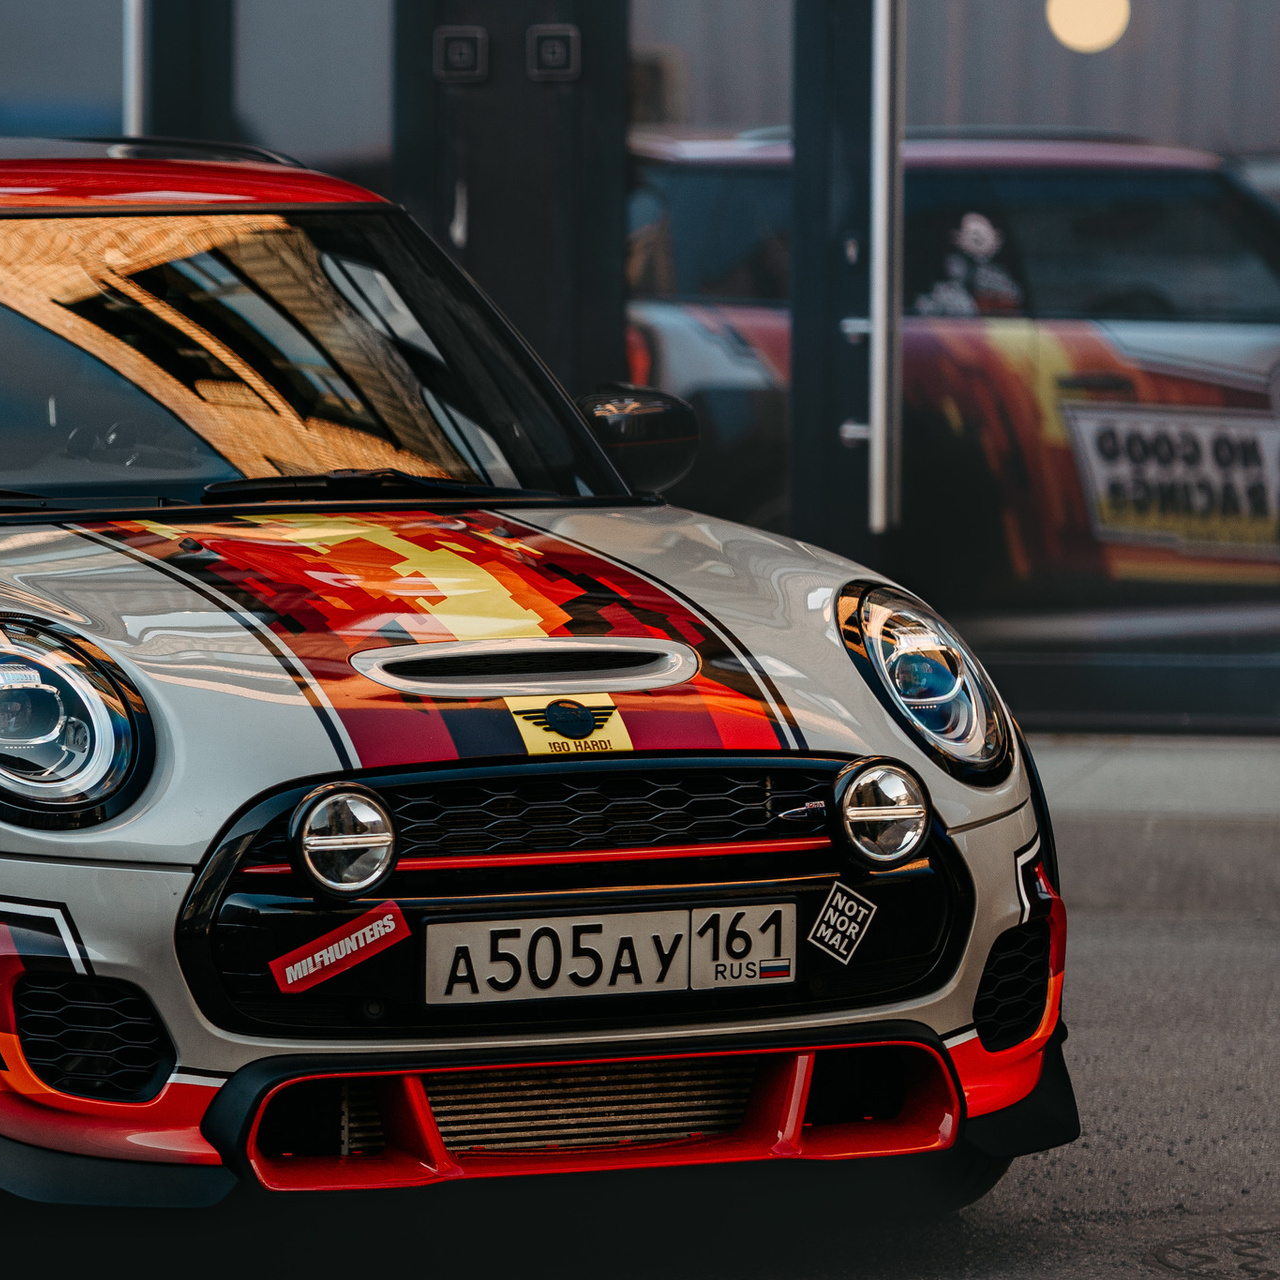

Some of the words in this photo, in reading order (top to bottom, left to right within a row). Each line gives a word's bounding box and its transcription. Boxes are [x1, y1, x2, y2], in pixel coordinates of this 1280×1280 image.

[548, 741, 571, 753] !GO
[573, 739, 613, 752] HARD!
[831, 891, 869, 923] NOT
[696, 909, 783, 962] 161
[815, 923, 850, 955] MAL
[823, 907, 860, 940] NOR
[285, 913, 396, 985] MILFHUNTERS
[714, 962, 758, 981] RUS
